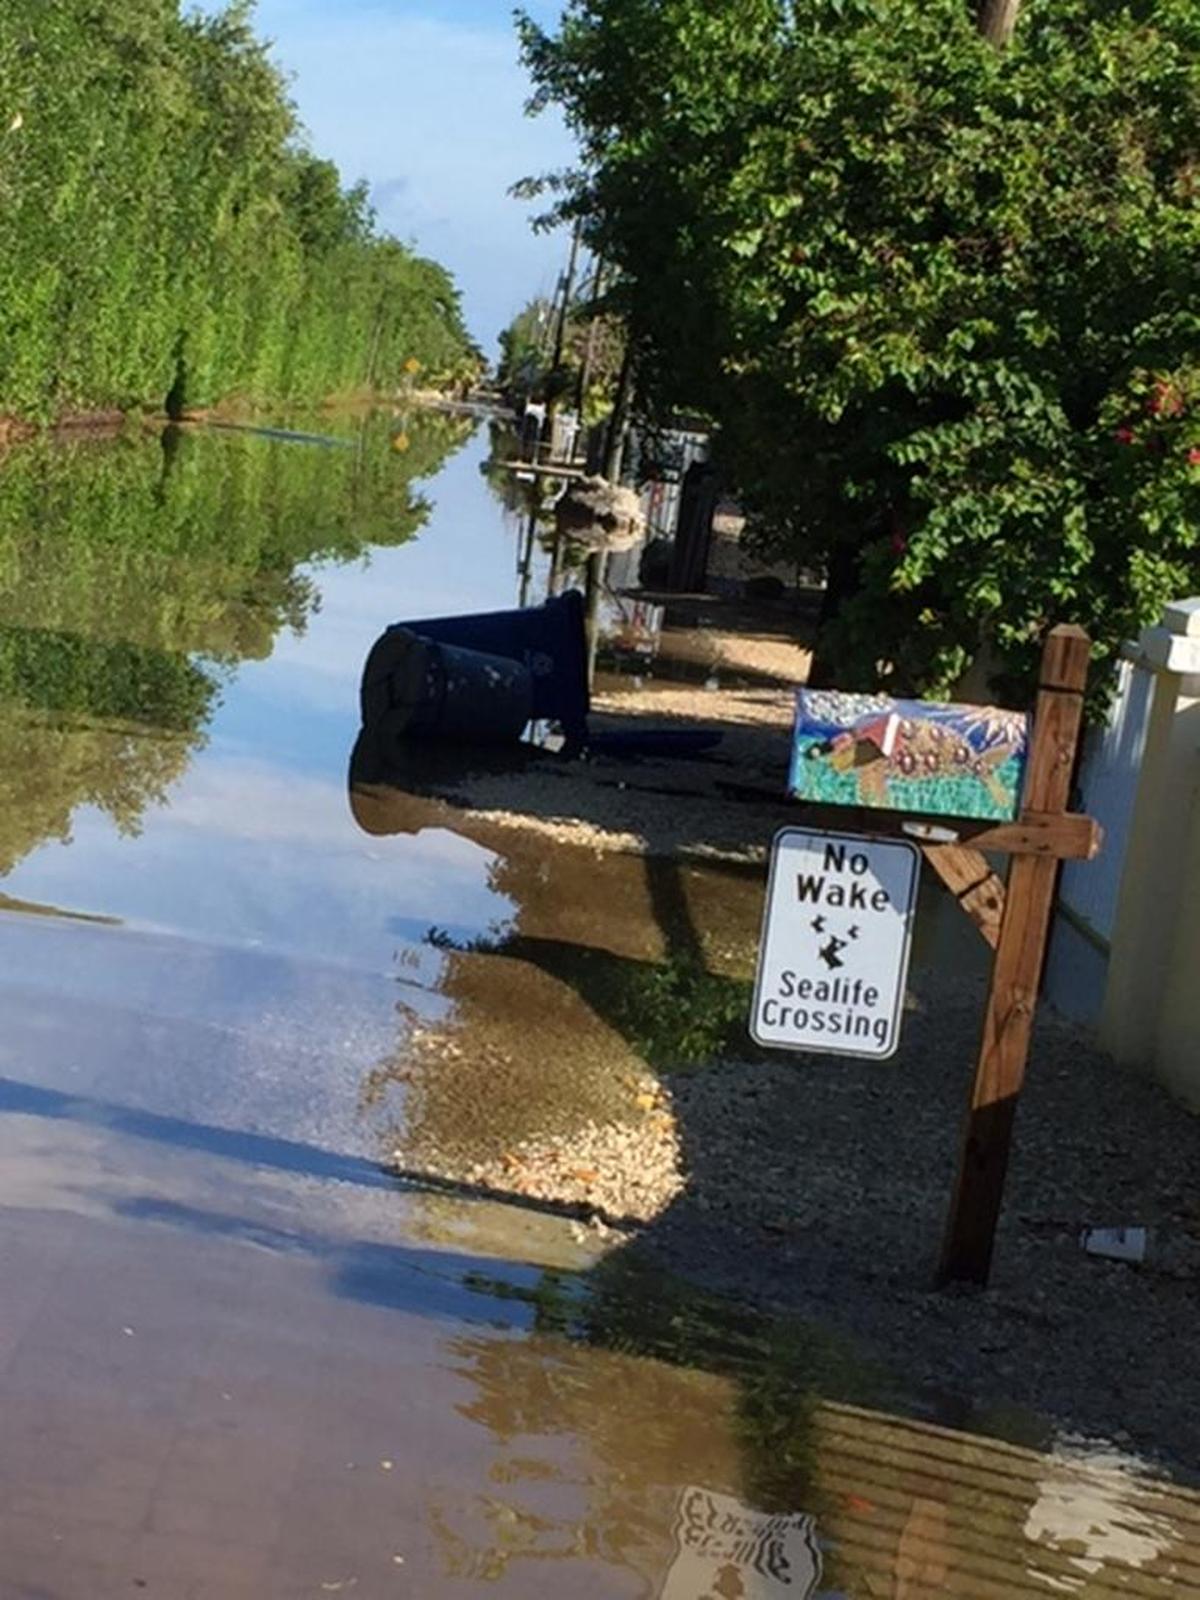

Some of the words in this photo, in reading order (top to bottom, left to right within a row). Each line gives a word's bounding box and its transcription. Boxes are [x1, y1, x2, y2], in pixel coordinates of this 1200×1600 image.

[824, 844, 868, 875] No
[797, 874, 890, 912] Wake
[779, 970, 879, 1007] Sealife
[762, 999, 889, 1047] Crossing
